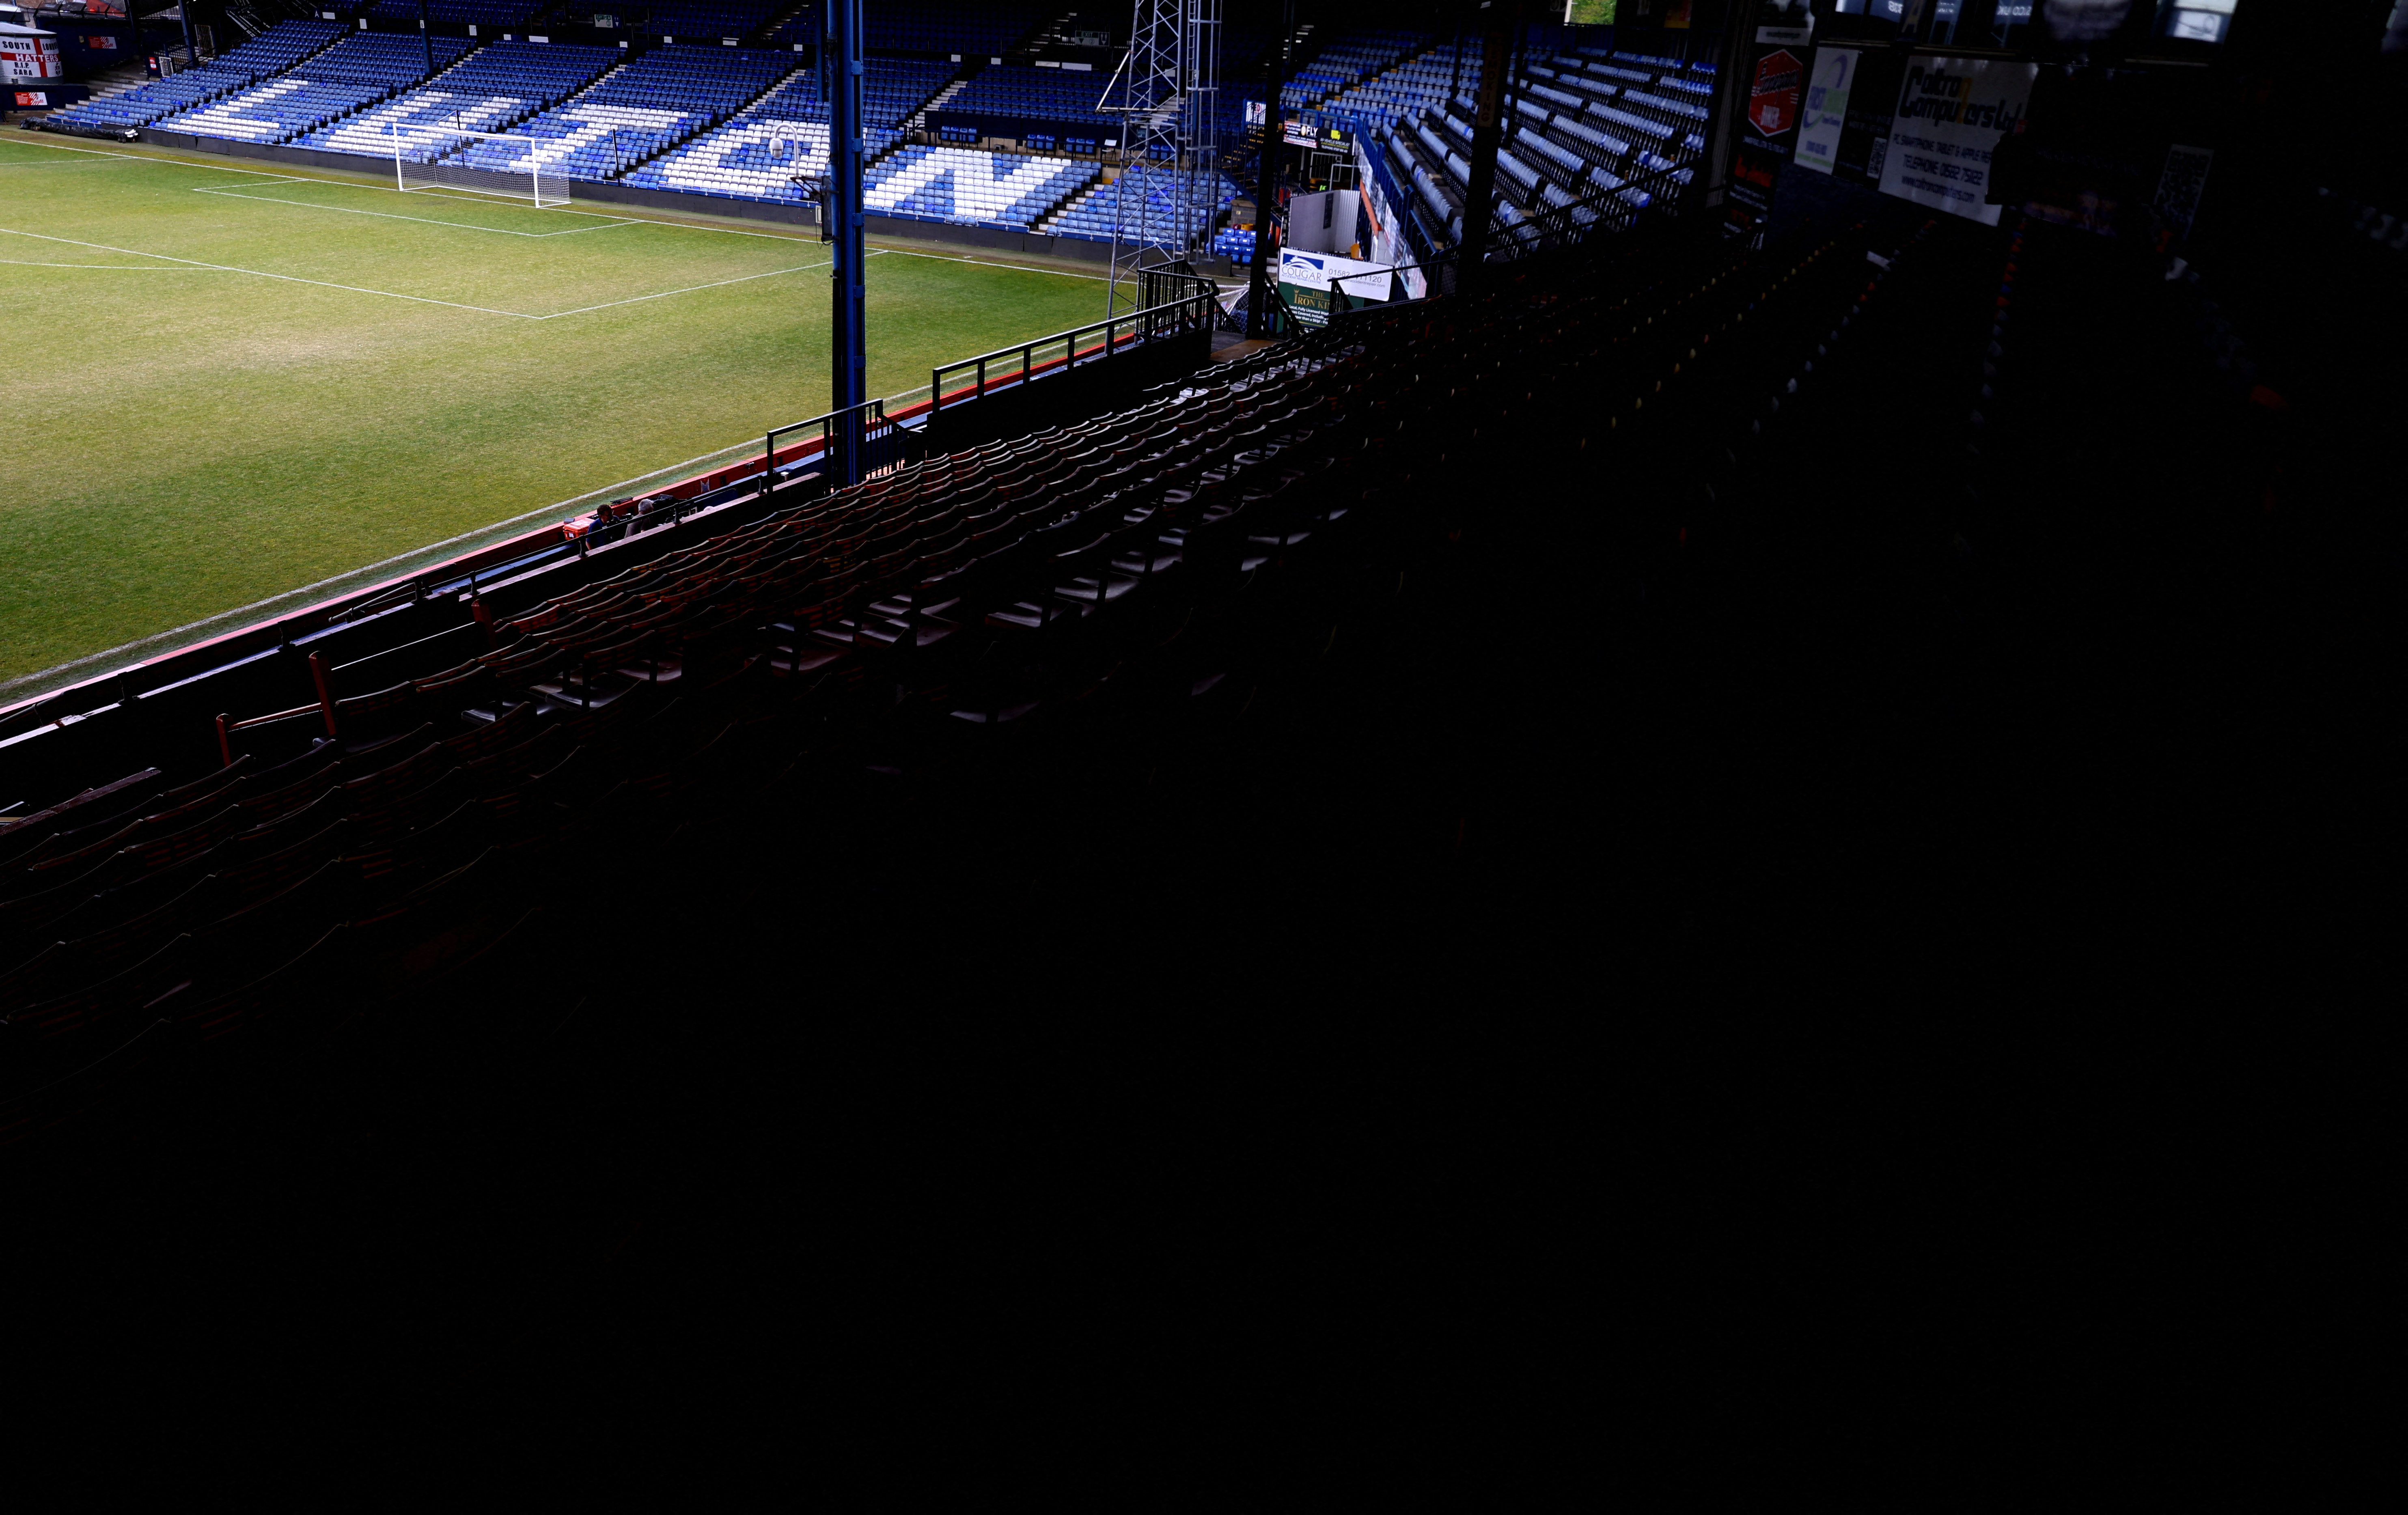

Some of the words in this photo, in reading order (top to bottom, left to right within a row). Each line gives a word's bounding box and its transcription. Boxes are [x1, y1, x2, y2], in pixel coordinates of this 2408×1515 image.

[2, 41, 31, 50] SOUTH
[15, 54, 58, 62] HATTERS
[1306, 125, 1319, 137] FLY
[1903, 154, 1939, 175] TELEPHONE
[1282, 266, 1321, 281] COUGAR
[1328, 268, 1350, 278] 01582
